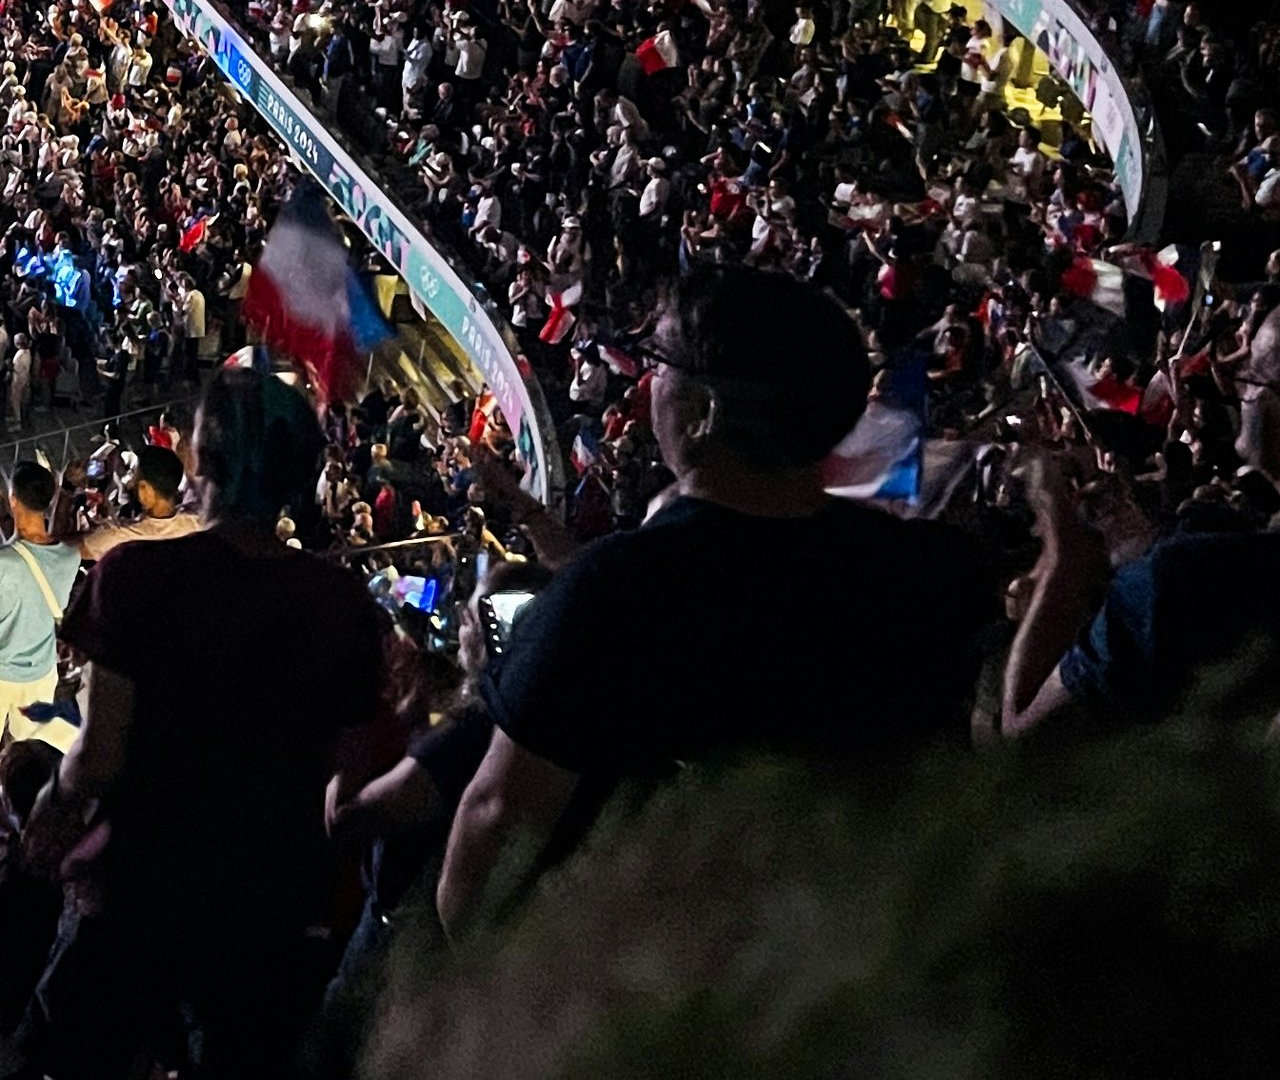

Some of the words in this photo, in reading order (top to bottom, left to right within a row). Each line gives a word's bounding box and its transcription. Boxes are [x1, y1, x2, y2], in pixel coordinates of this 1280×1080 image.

[267, 94, 294, 135] PARIS
[293, 124, 318, 165] 2024
[462, 315, 492, 370] PARIS
[491, 360, 513, 414] 2024
